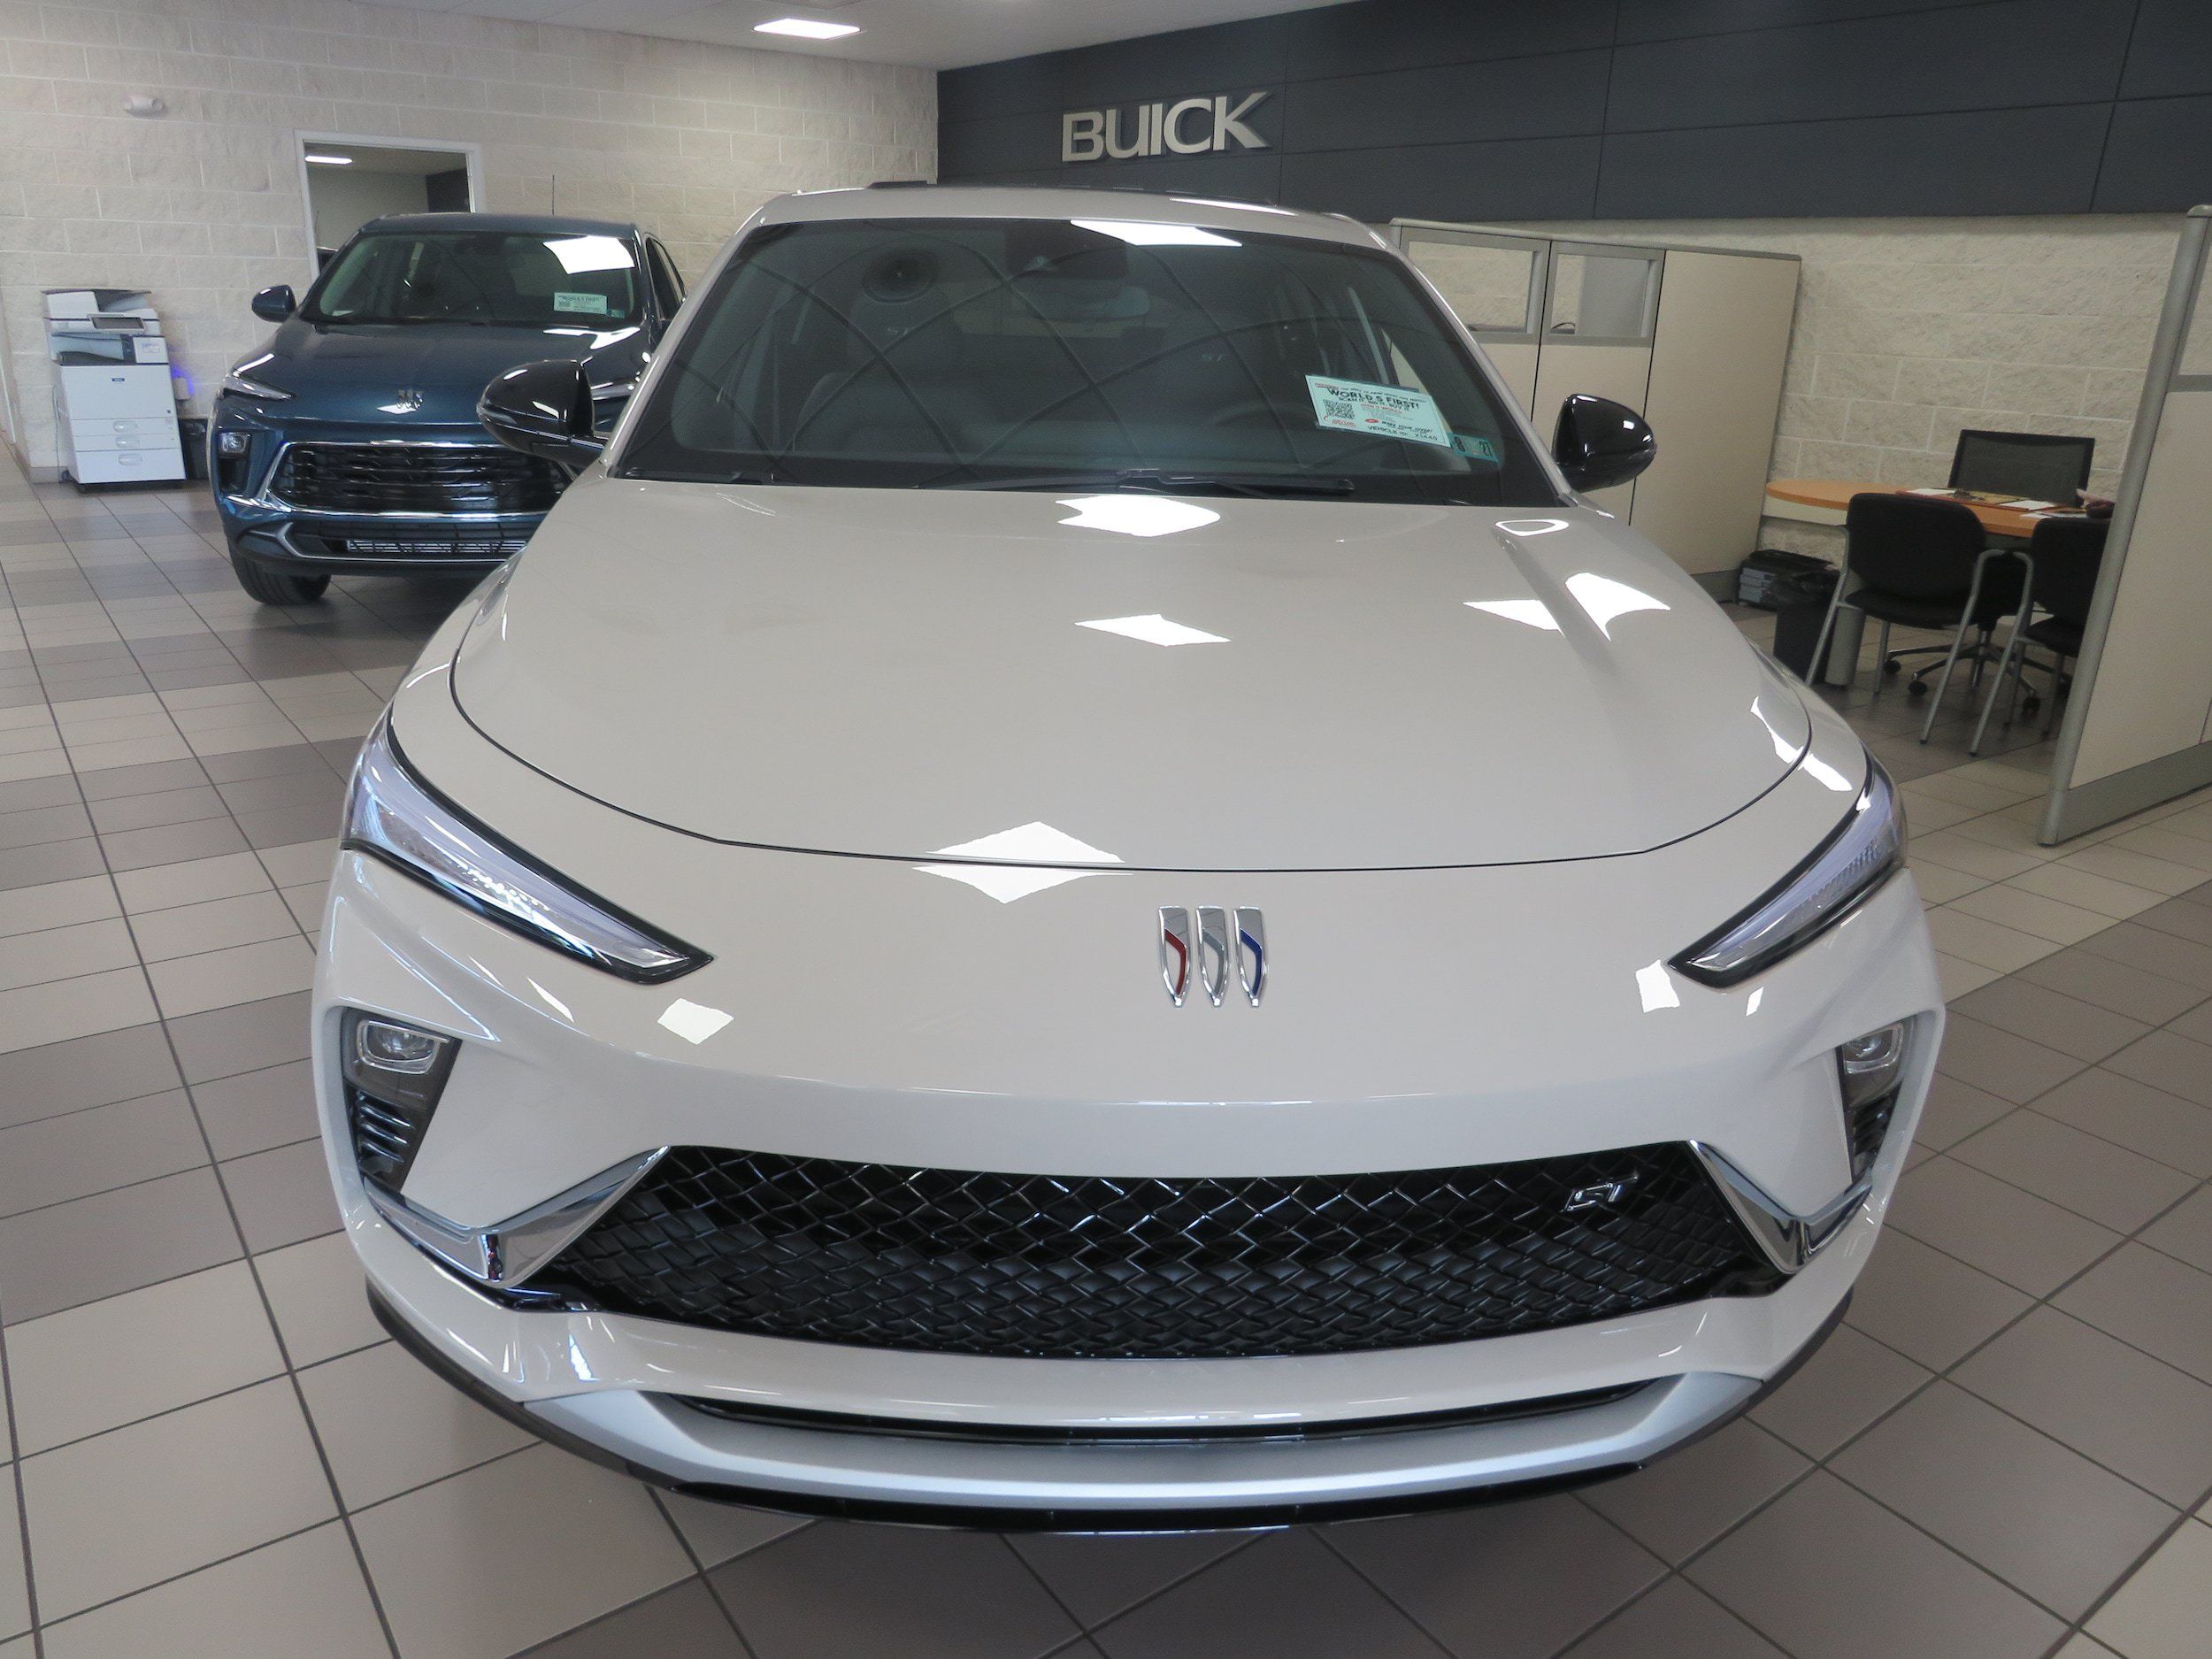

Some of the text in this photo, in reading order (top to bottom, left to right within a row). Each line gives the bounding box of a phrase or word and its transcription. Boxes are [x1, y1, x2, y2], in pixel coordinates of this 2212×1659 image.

[1062, 91, 1268, 162] BUICK
[1326, 388, 1384, 403] WORLDS
[1385, 396, 1420, 409] FIRST!
[1367, 425, 1398, 434] VEHICLE
